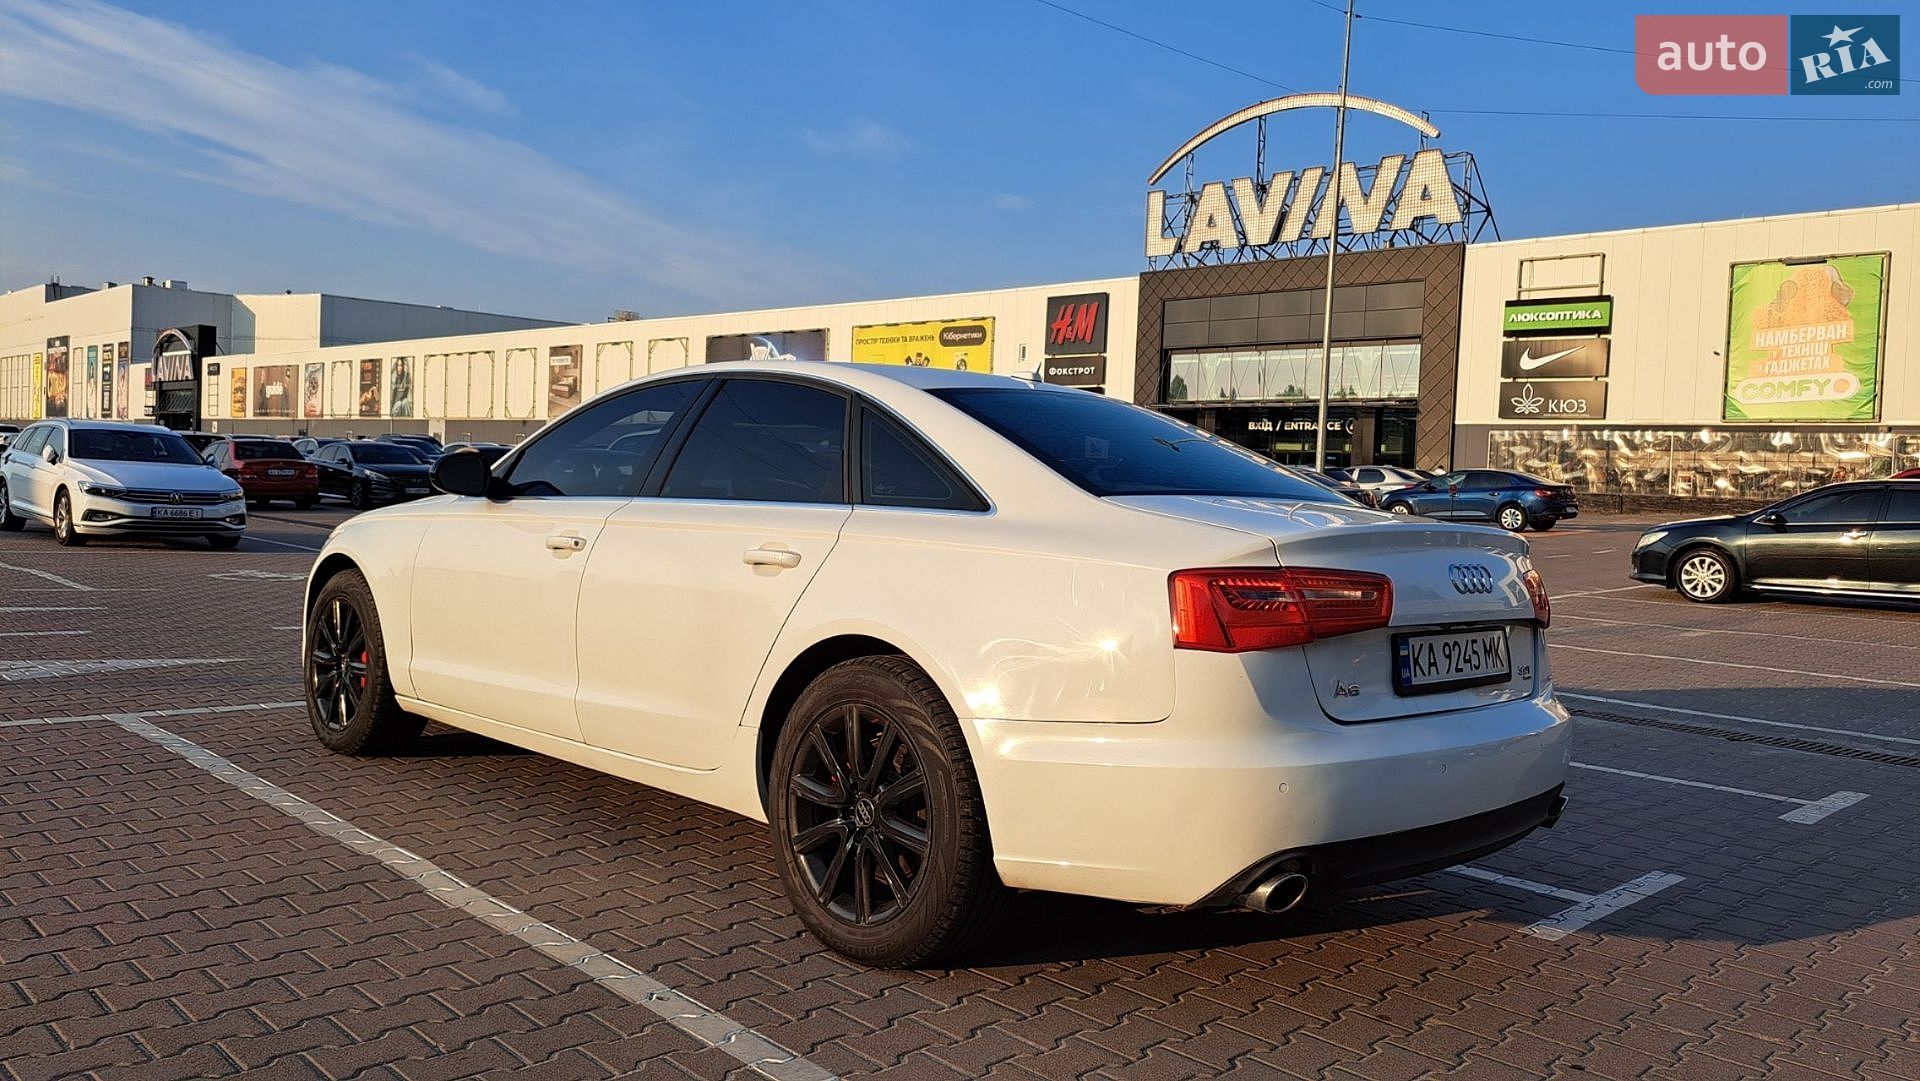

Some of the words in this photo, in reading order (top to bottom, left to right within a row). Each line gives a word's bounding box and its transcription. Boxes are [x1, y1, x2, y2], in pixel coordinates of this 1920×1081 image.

[1145, 149, 1464, 257] LAVINA
[1049, 301, 1098, 345] H&M
[1508, 309, 1602, 323] ЛЮКСОПТИКА
[1754, 322, 1847, 348] НАМБЕРВАН
[1782, 343, 1829, 358] ТЕХНІЦІ
[1048, 366, 1096, 376] ФОКСТРОТ
[1741, 379, 1832, 400] COMFY
[1548, 398, 1588, 414] КЮЗ
[1284, 421, 1341, 430] ENTRACE
[1411, 642, 1440, 678] KA
[1442, 639, 1481, 675] 9245
[1482, 636, 1505, 669] MK
